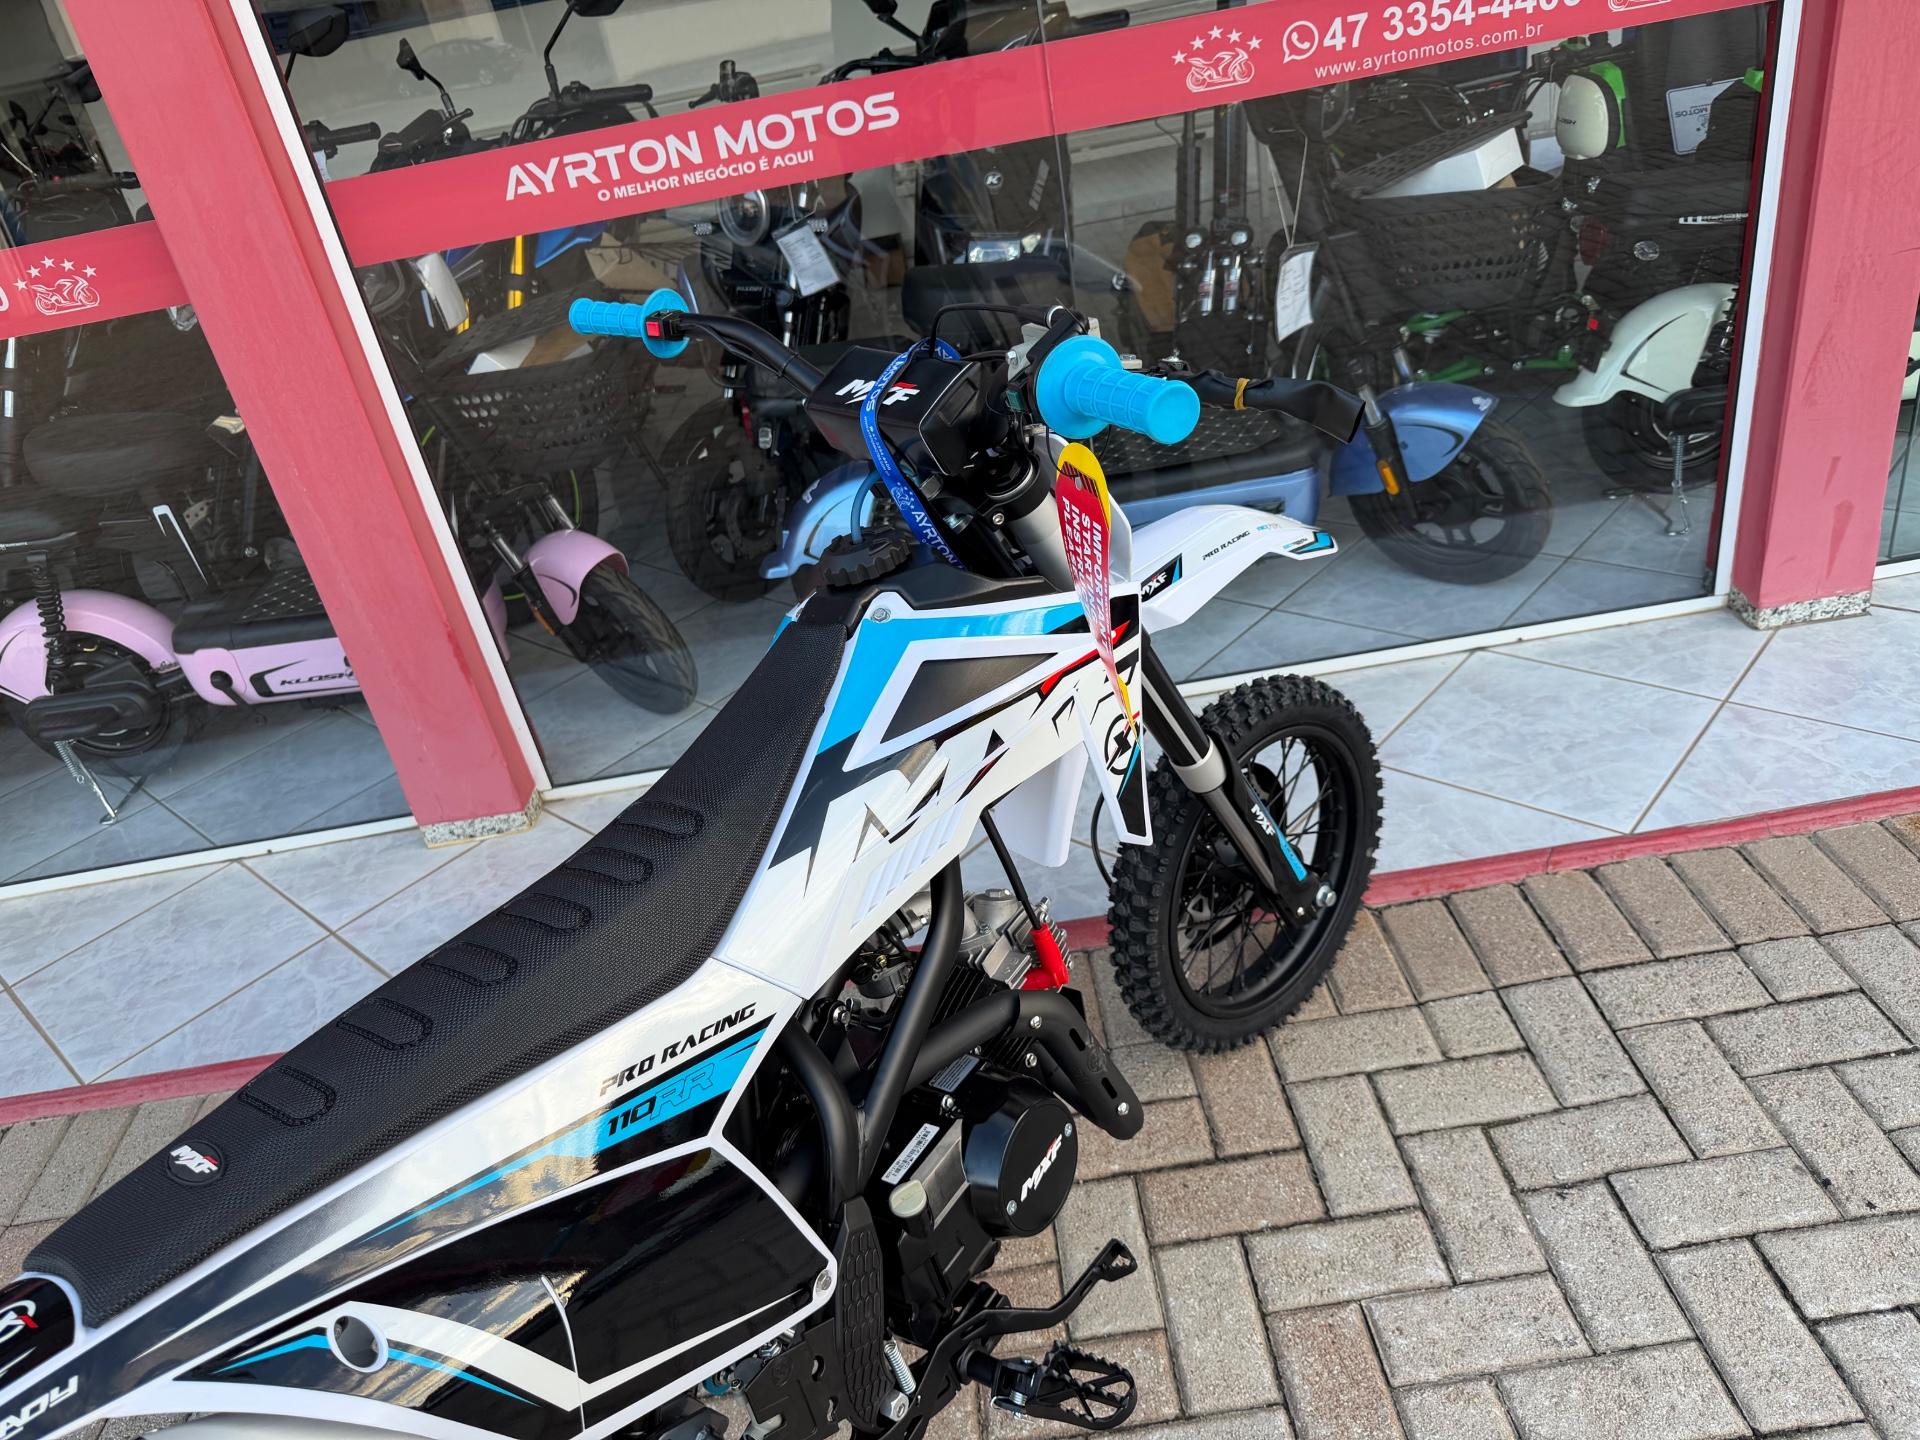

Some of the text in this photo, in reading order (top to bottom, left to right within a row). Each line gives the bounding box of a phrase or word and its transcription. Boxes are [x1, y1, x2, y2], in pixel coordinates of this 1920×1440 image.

[1314, 22, 1544, 79] www.ayrtonmotos.com.br
[1322, 0, 1582, 51] 47 3354-4
[505, 91, 900, 201] AYRTON MOTOS
[597, 149, 815, 202] O MELHOR NEGÓCIO É AQUI
[911, 511, 958, 563] AYRTON
[1202, 530, 1250, 561] PRO RACING
[1092, 520, 1109, 649] IMPORTANT
[1250, 803, 1276, 836] MXF
[600, 1001, 757, 1097] PRO RACING
[169, 1144, 219, 1174] MXF
[1020, 1133, 1063, 1202] MXF
